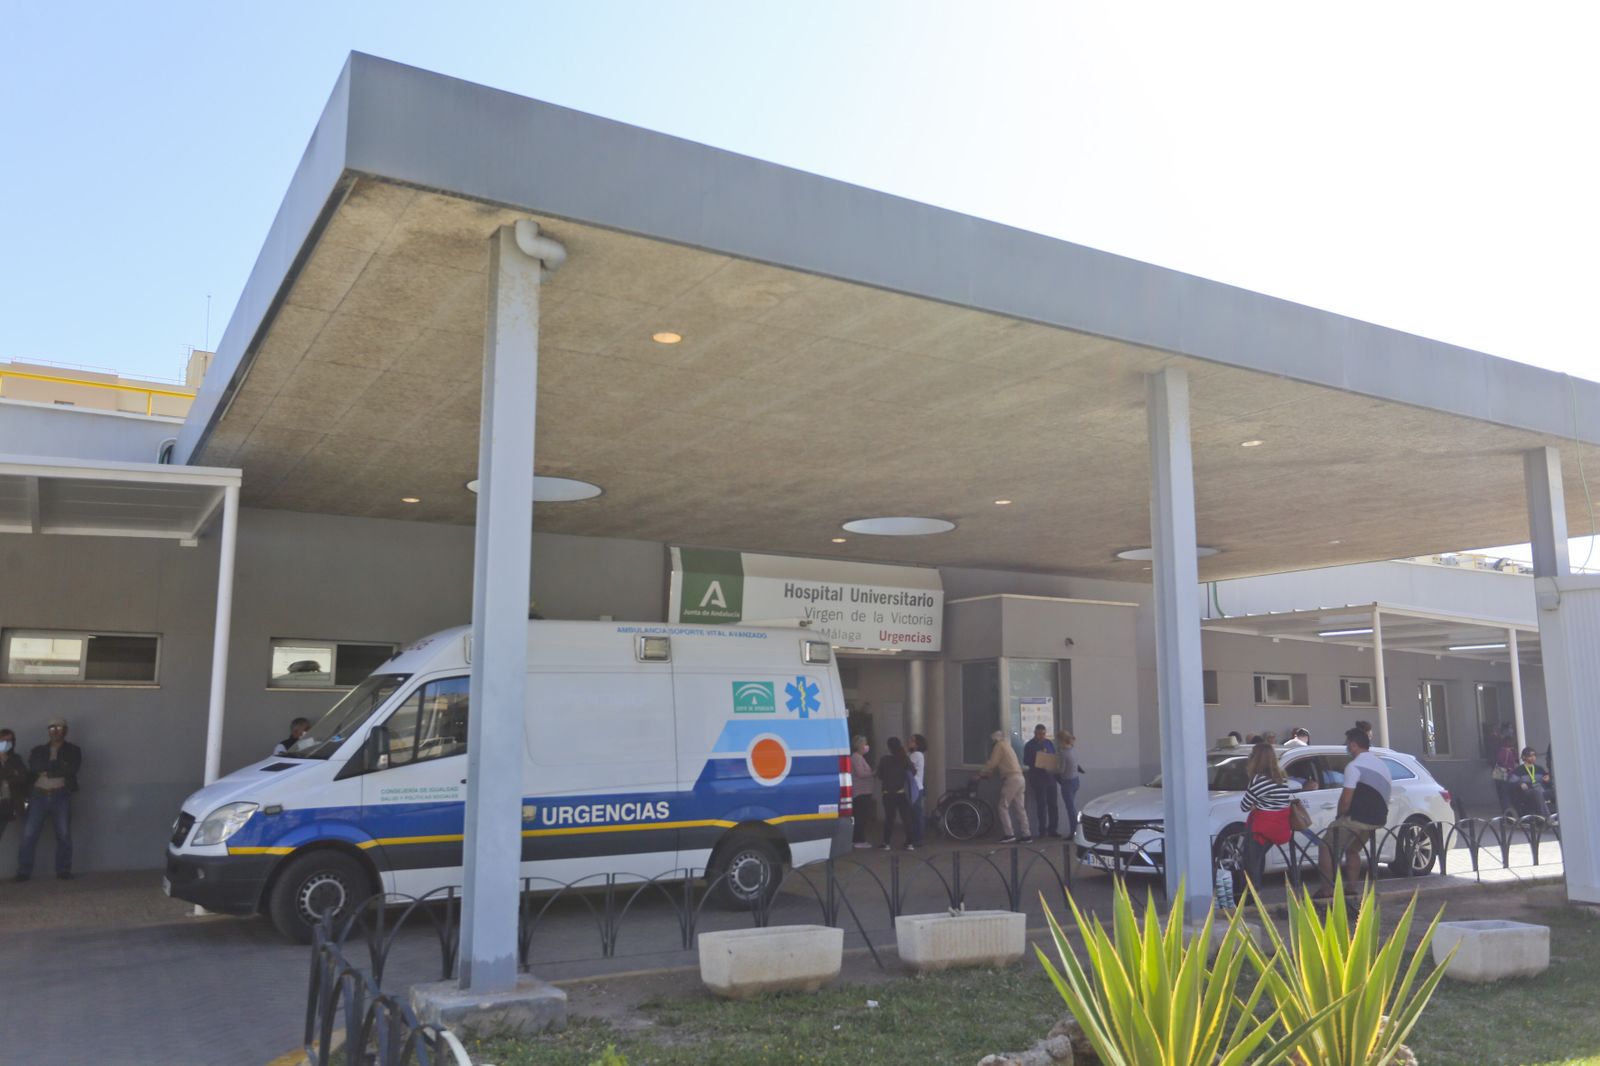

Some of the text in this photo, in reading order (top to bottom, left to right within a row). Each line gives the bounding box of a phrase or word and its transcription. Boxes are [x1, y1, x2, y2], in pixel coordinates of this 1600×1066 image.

[784, 583, 934, 608] Hospital Universitario
[804, 606, 934, 626] Virgen de la Victoria
[616, 626, 667, 634] AMBULANCIA
[669, 628, 705, 636] SOPORTE
[728, 631, 768, 639] AVANZADO
[879, 629, 932, 645] Urgencias
[542, 801, 670, 825] URGENCIAS
